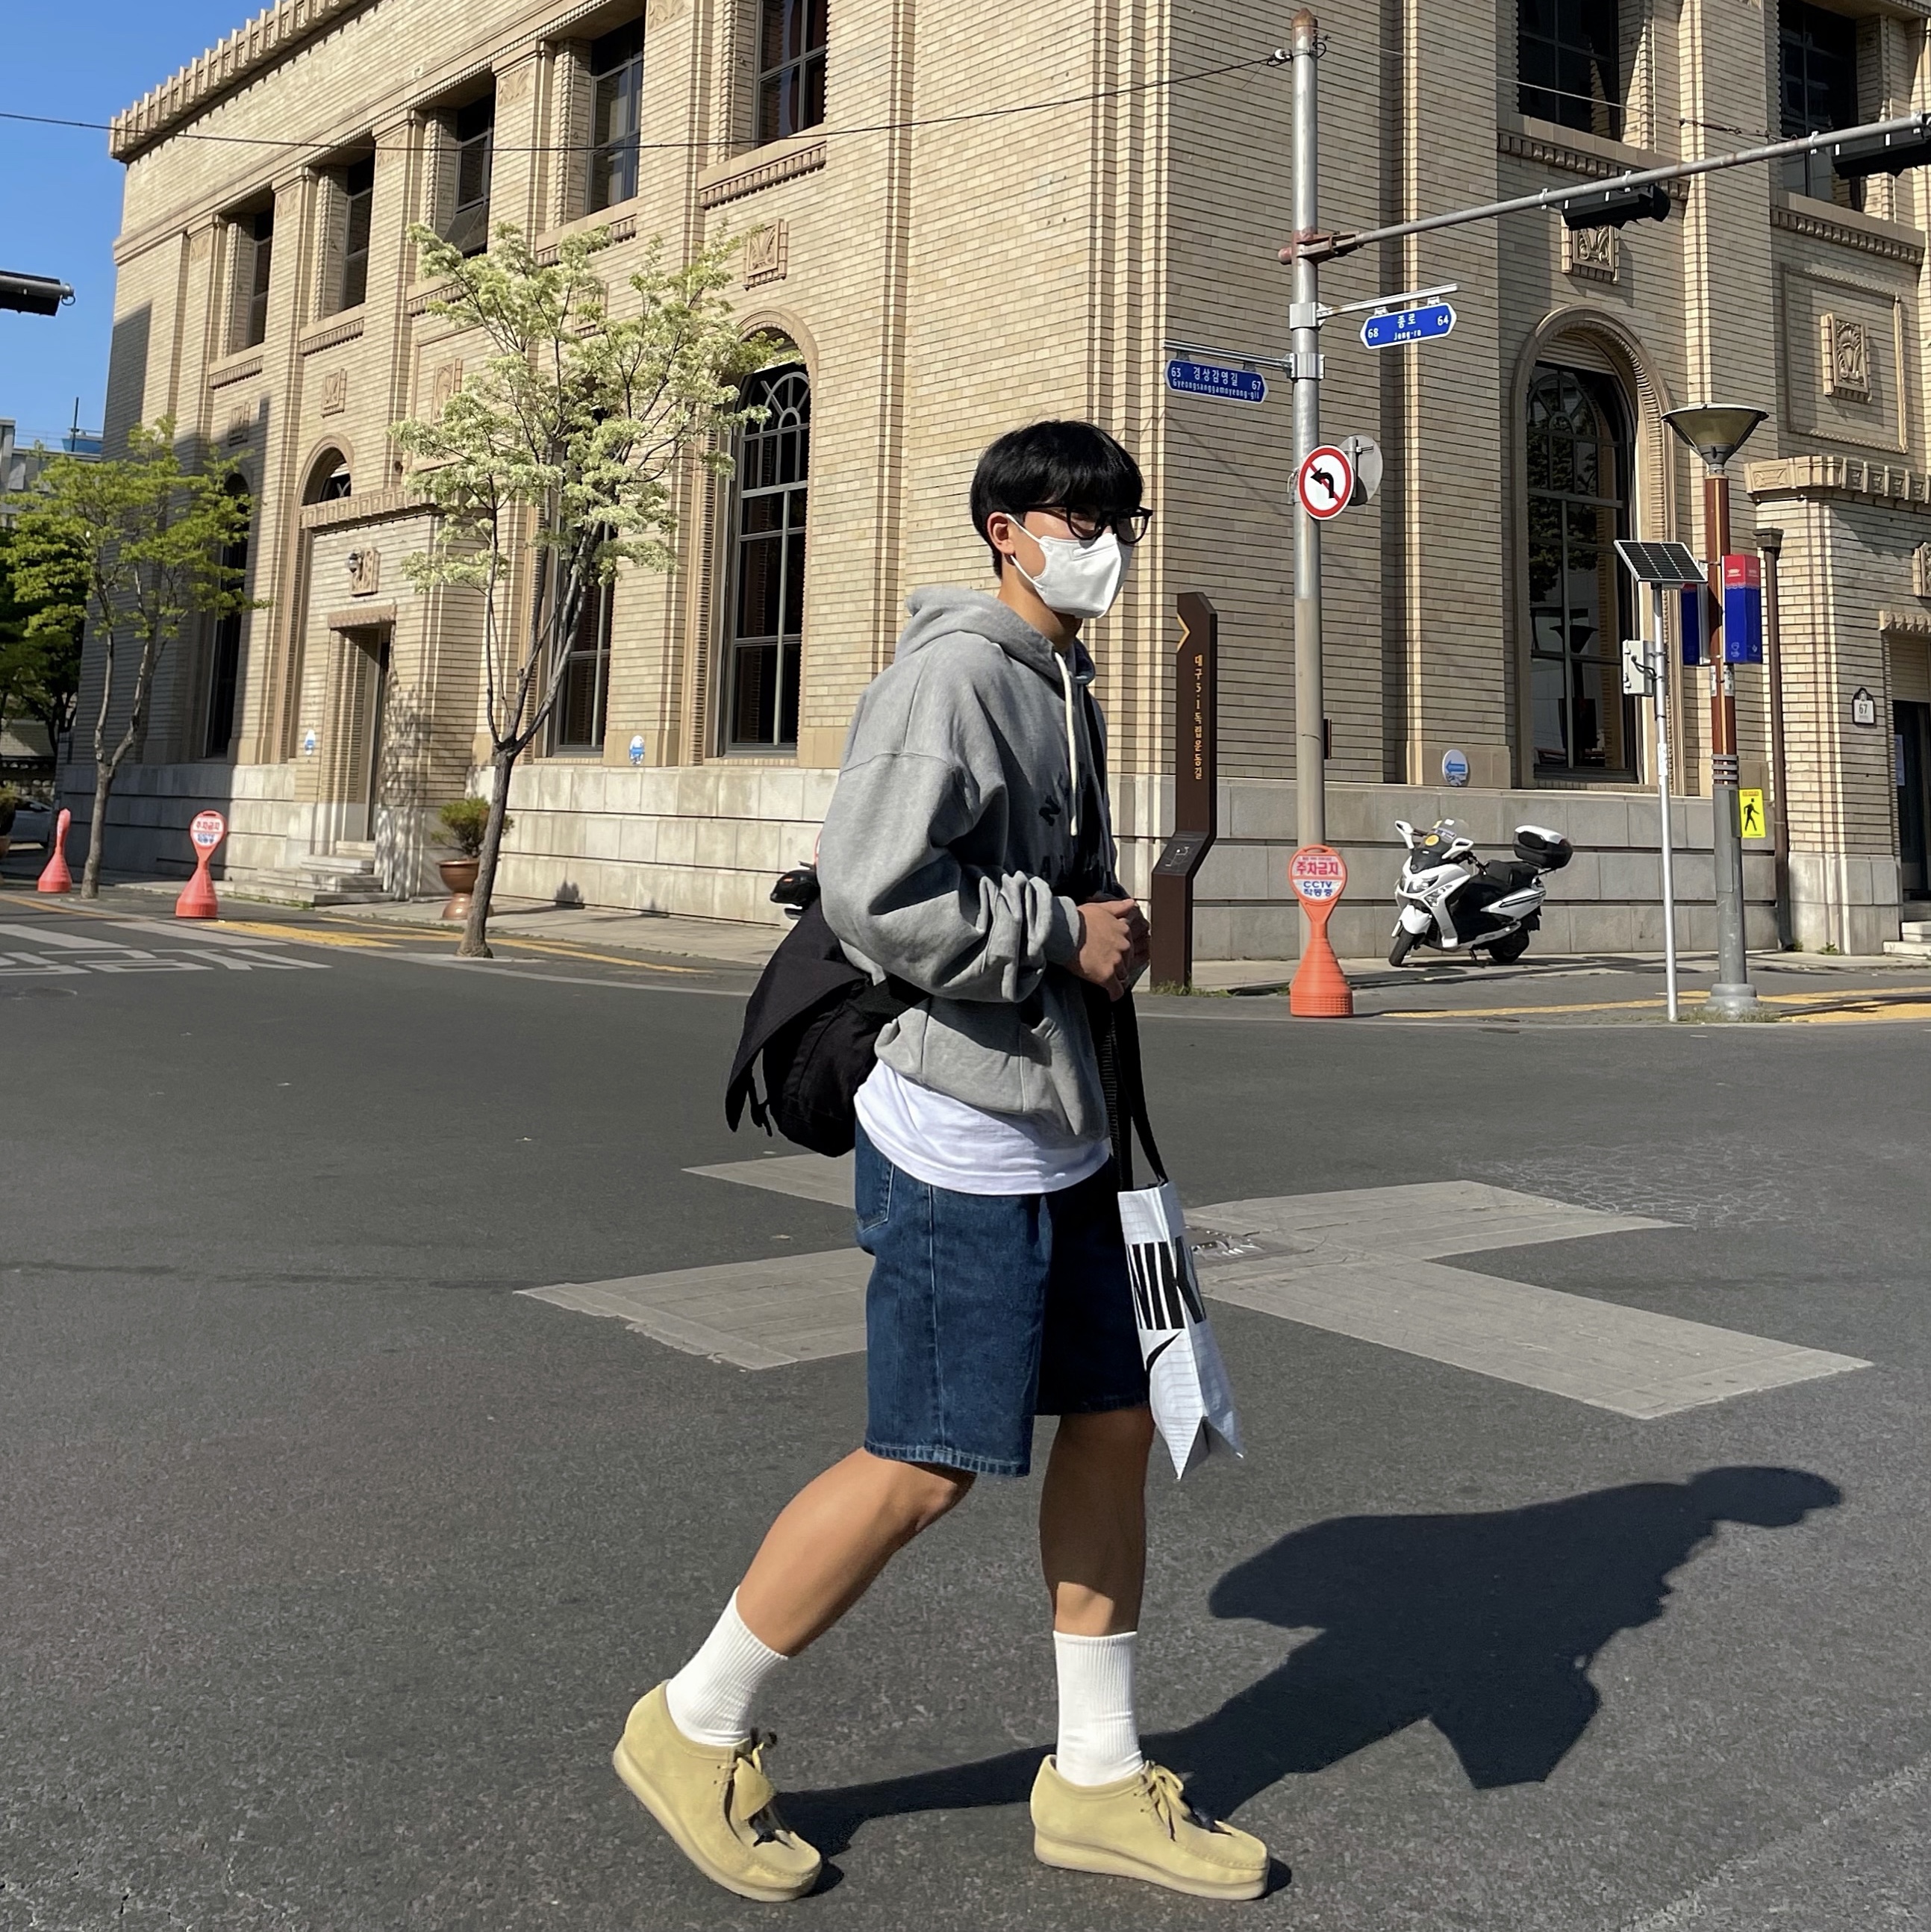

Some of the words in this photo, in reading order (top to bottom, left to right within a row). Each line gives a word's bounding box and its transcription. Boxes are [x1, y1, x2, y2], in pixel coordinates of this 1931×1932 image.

[1367, 328, 1379, 338] 68
[1397, 313, 1416, 328] 종로
[1437, 315, 1449, 325] 64
[1394, 329, 1421, 340] Jong-ro
[1171, 367, 1181, 377] 63
[1193, 367, 1238, 386] 경상감영길
[1251, 381, 1261, 390] 67
[1859, 703, 1868, 714] 67
[1297, 861, 1338, 875] 주차금지
[1126, 1235, 1206, 1330] NIK
